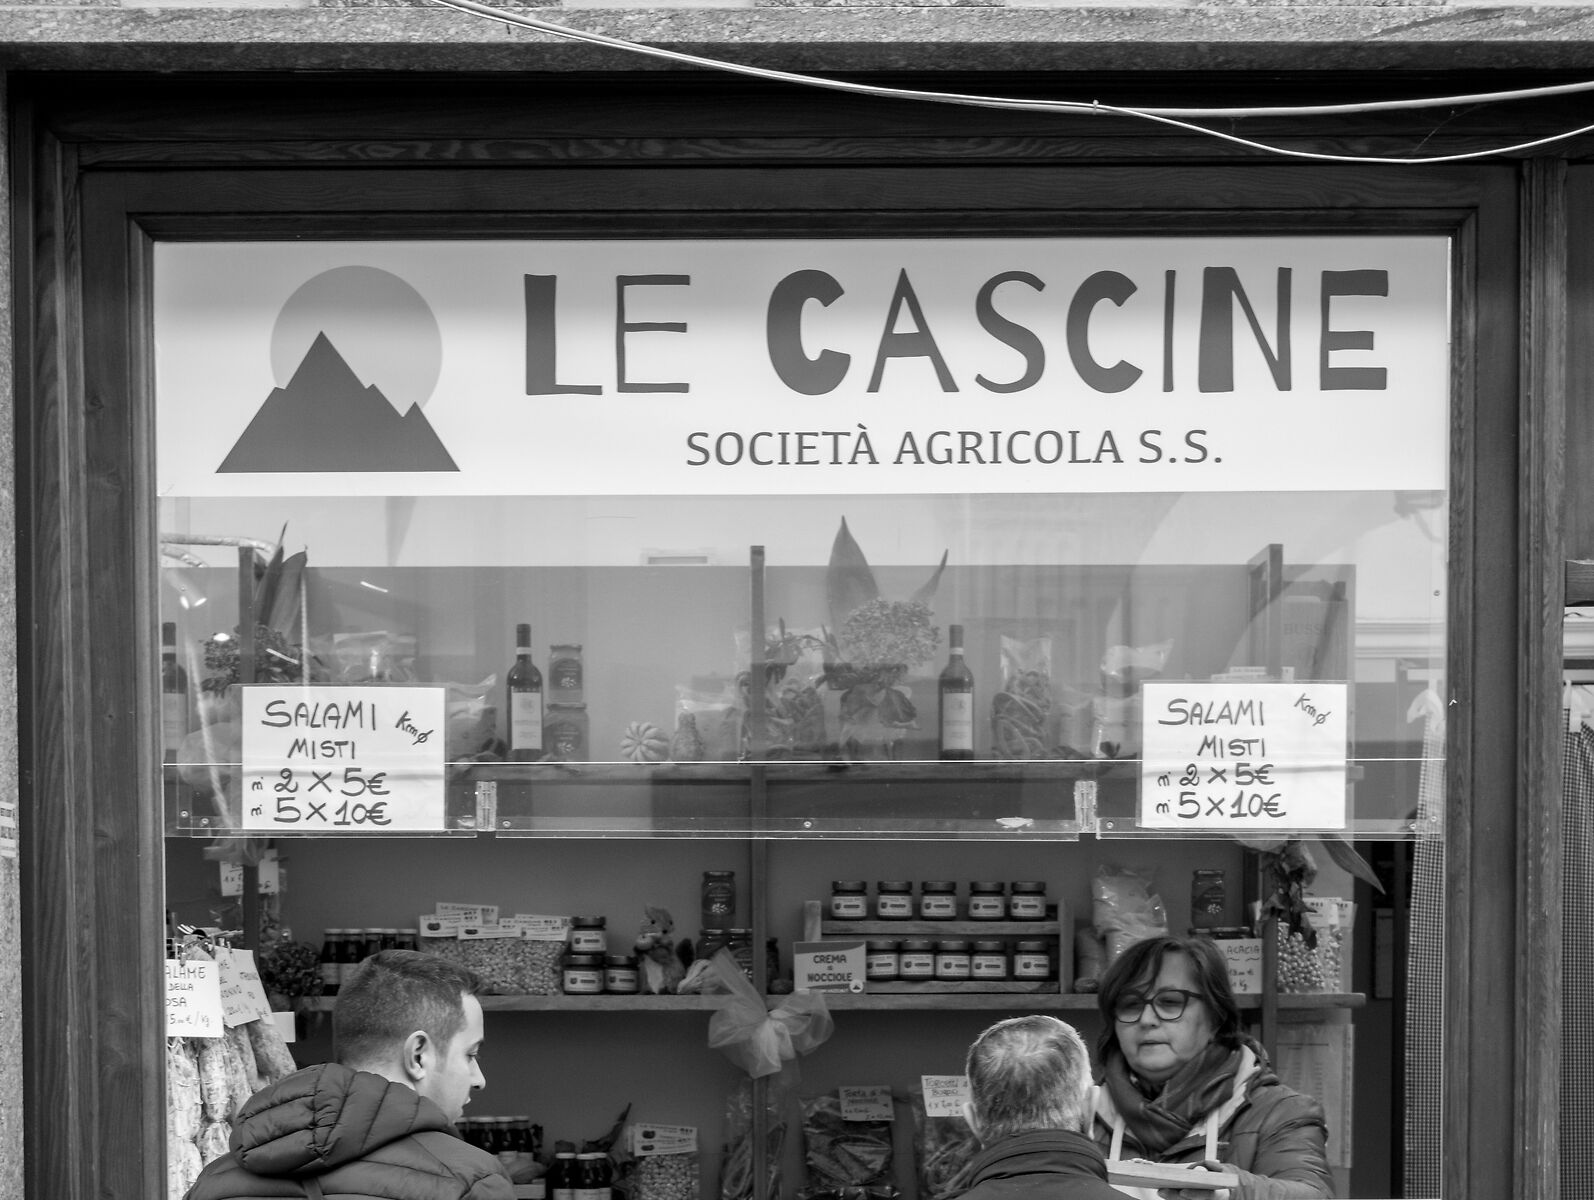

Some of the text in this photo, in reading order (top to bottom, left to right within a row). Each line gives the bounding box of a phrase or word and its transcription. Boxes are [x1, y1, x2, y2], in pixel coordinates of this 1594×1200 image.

[524, 266, 1388, 396] LE CASCINE
[687, 423, 1223, 465] SOCIETÀ AGRICOLA S.S.
[261, 699, 376, 731] SALAMI
[1158, 698, 1264, 726] SALAMI
[287, 738, 355, 759] MISTI
[1197, 735, 1265, 758] MISTI
[813, 954, 847, 964] CREMA
[165, 965, 206, 979] ALAME
[808, 972, 853, 982] NOCCIOLE
[165, 997, 187, 1007] OSA
